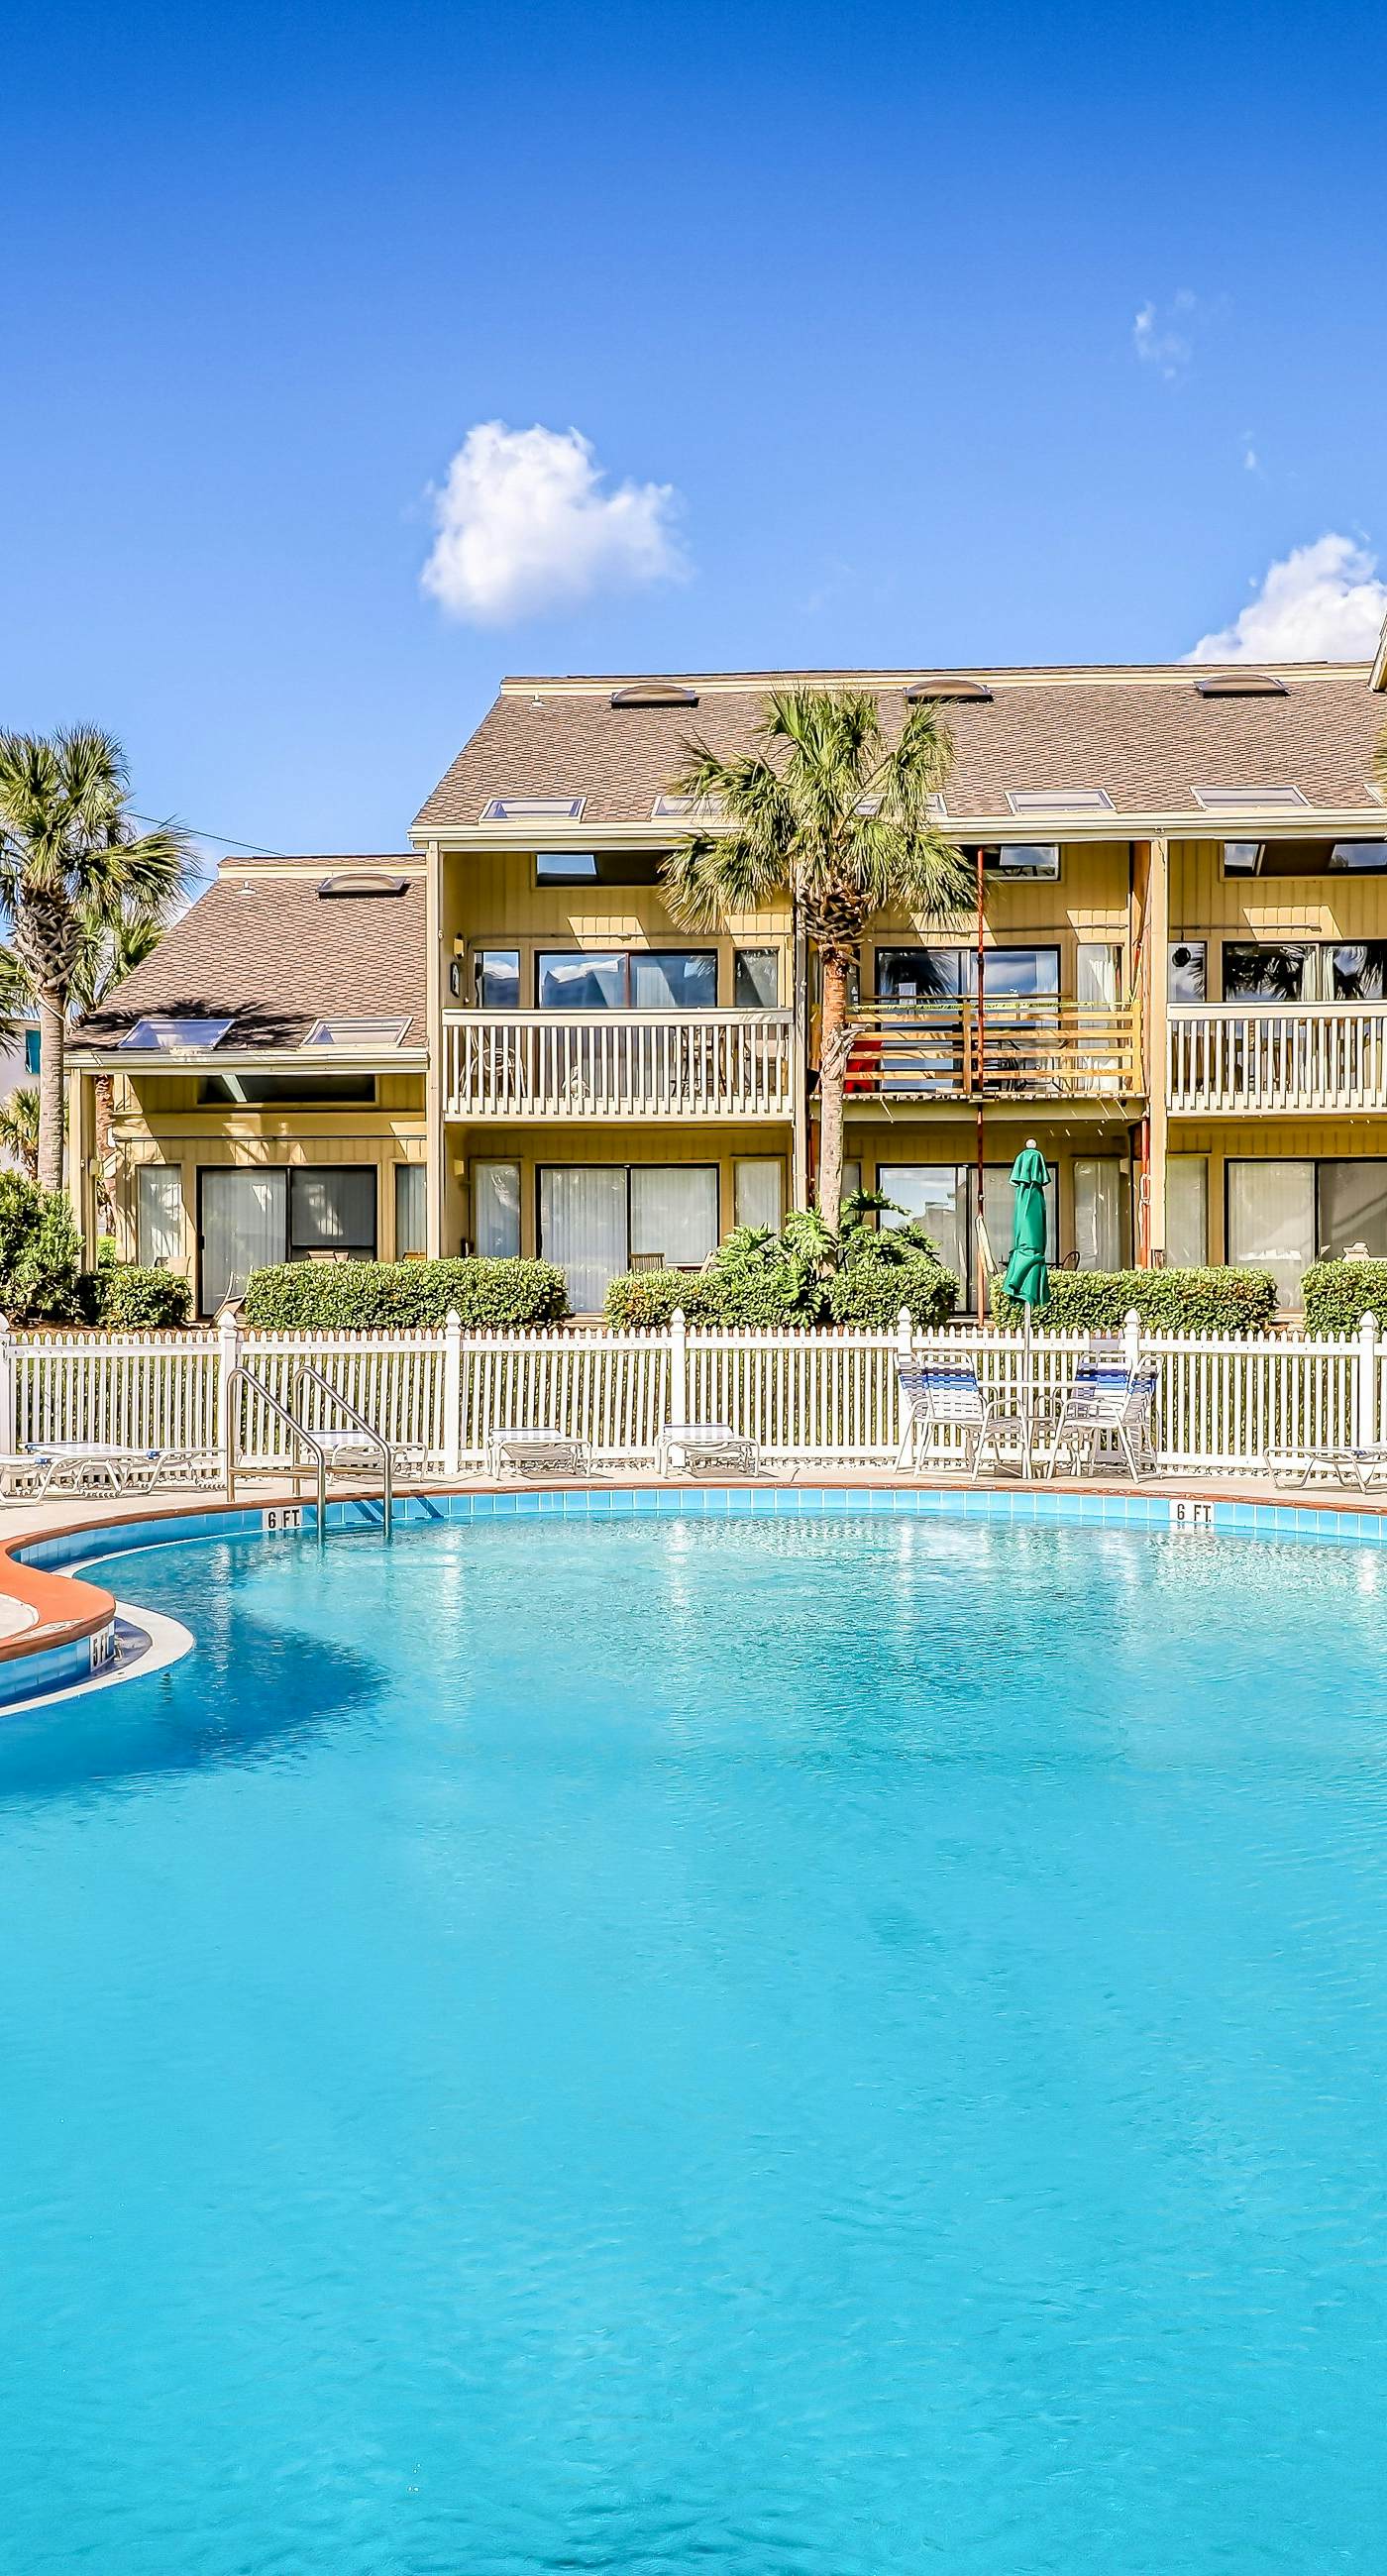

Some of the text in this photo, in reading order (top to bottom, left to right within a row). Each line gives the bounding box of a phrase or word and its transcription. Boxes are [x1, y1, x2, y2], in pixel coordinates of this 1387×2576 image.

[267, 1509, 300, 1529] 6 FT.
[1177, 1503, 1212, 1523] 6 FT.
[93, 1638, 98, 1666] 5
